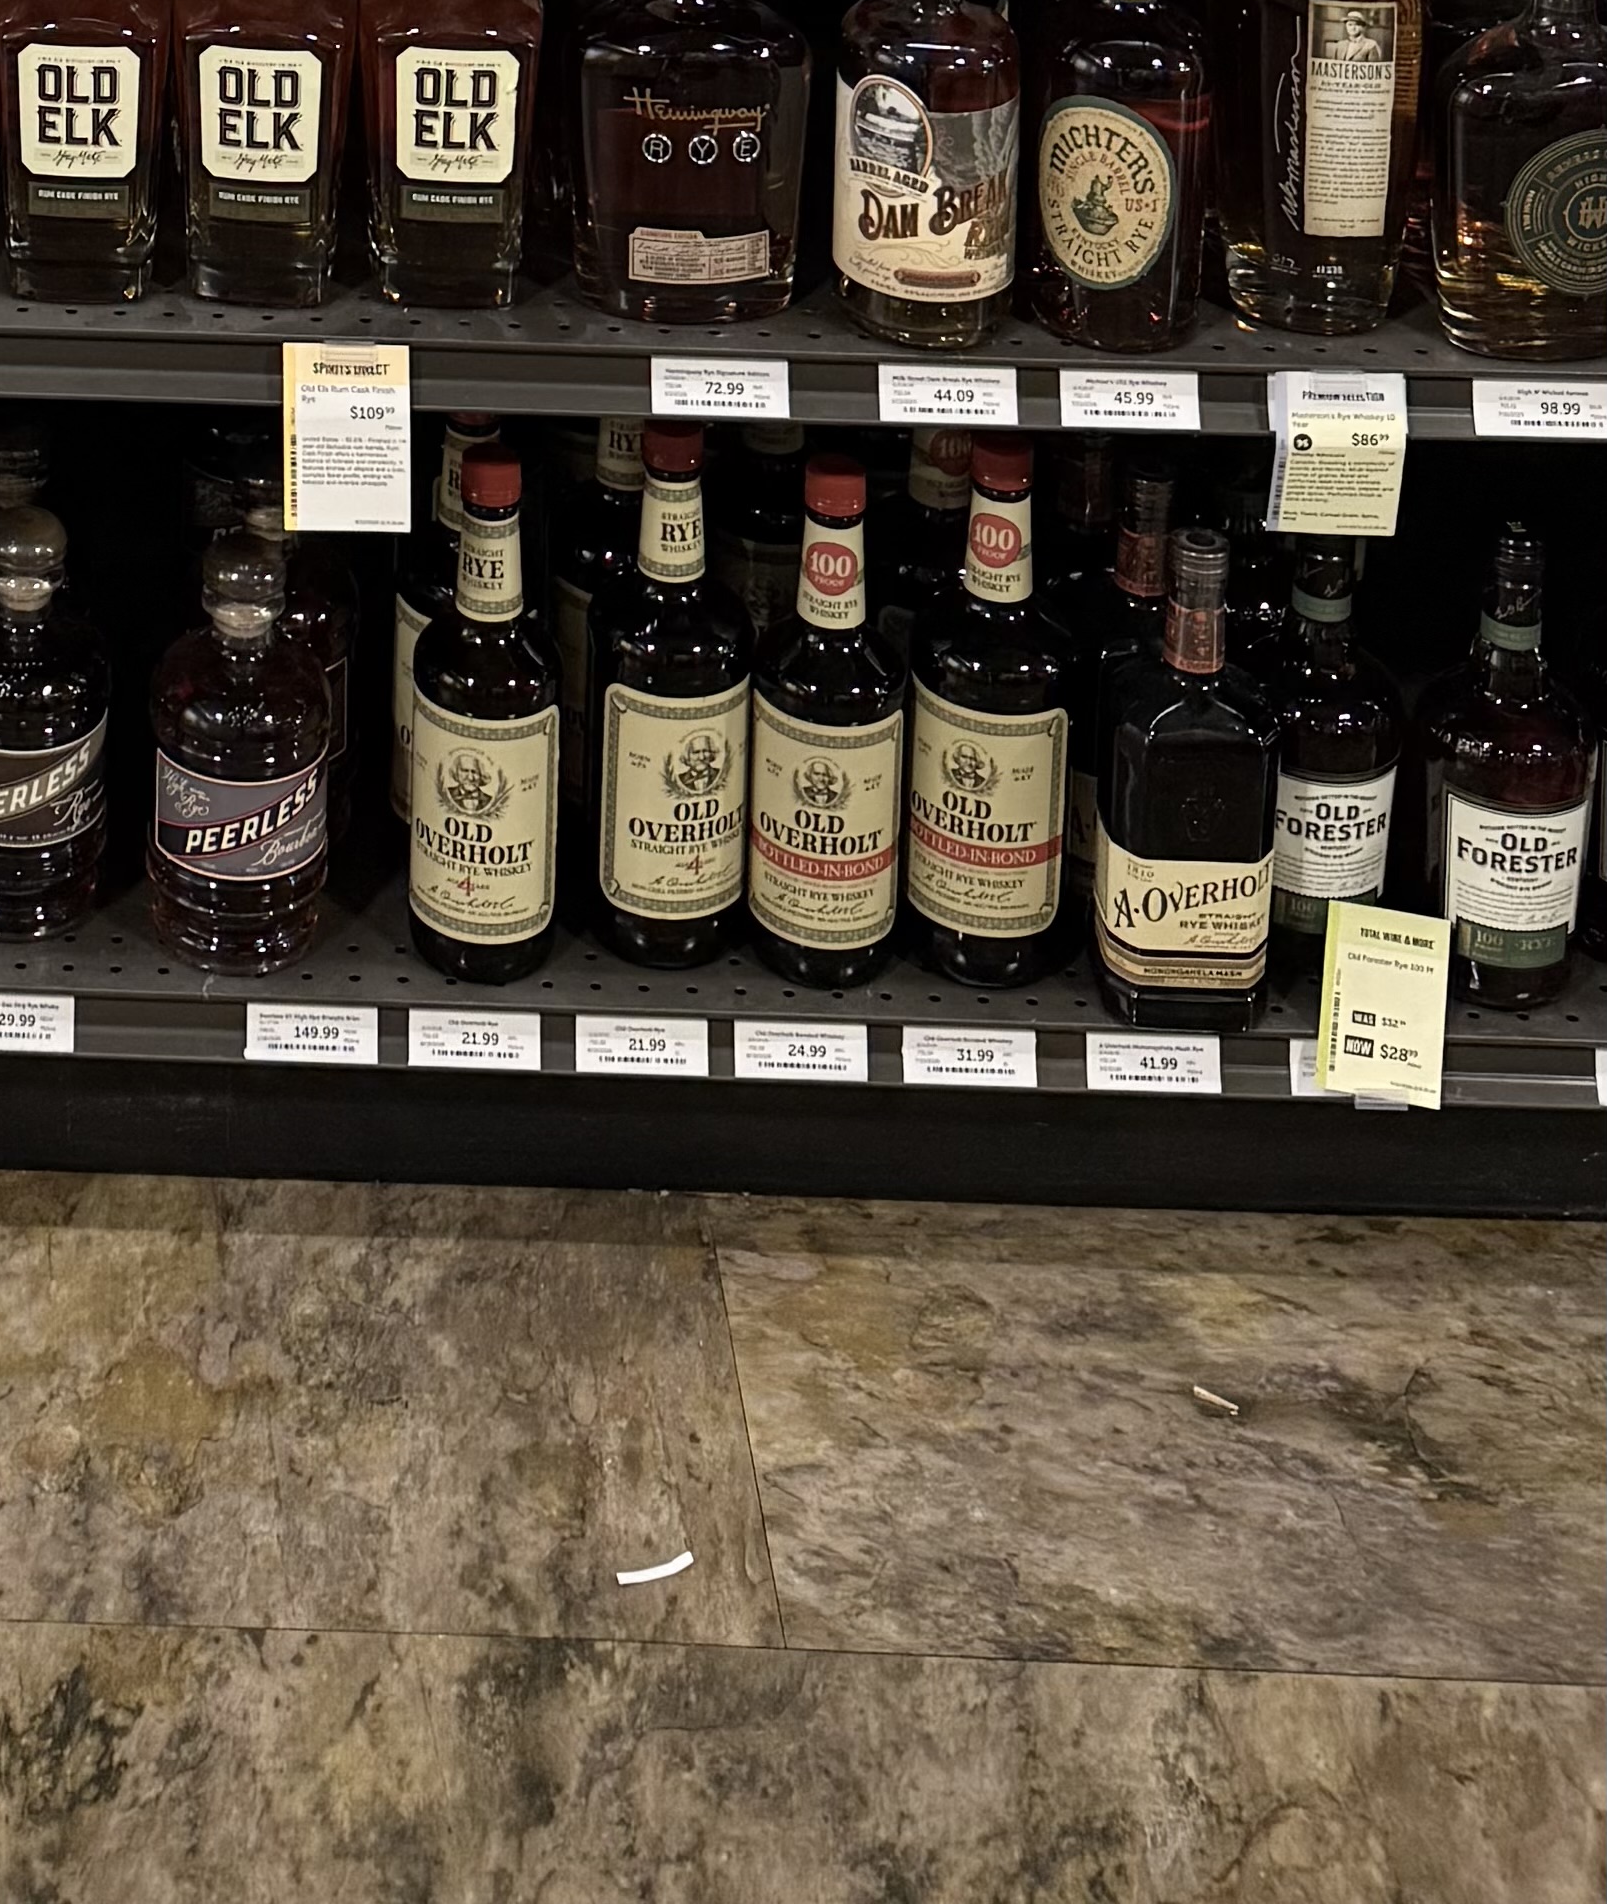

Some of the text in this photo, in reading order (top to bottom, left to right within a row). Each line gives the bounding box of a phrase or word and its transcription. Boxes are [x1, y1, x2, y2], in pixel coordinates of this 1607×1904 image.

[1311, 62, 1392, 81] MASTERSON'S
[218, 65, 303, 108] OLD
[623, 86, 770, 131] Hemingway
[218, 108, 303, 151] ELK
[704, 381, 745, 396] 72.99
[1540, 401, 1582, 416] 98.99
[809, 555, 851, 576] 100
[444, 817, 493, 844] OLD
[416, 817, 533, 865] OVERHOLT
[1500, 833, 1548, 852] OLD
[1457, 837, 1578, 875] FORESTER
[294, 1026, 339, 1040] 149.99
[788, 1044, 826, 1057] 24.99
[1139, 1057, 1178, 1070] 41.99
